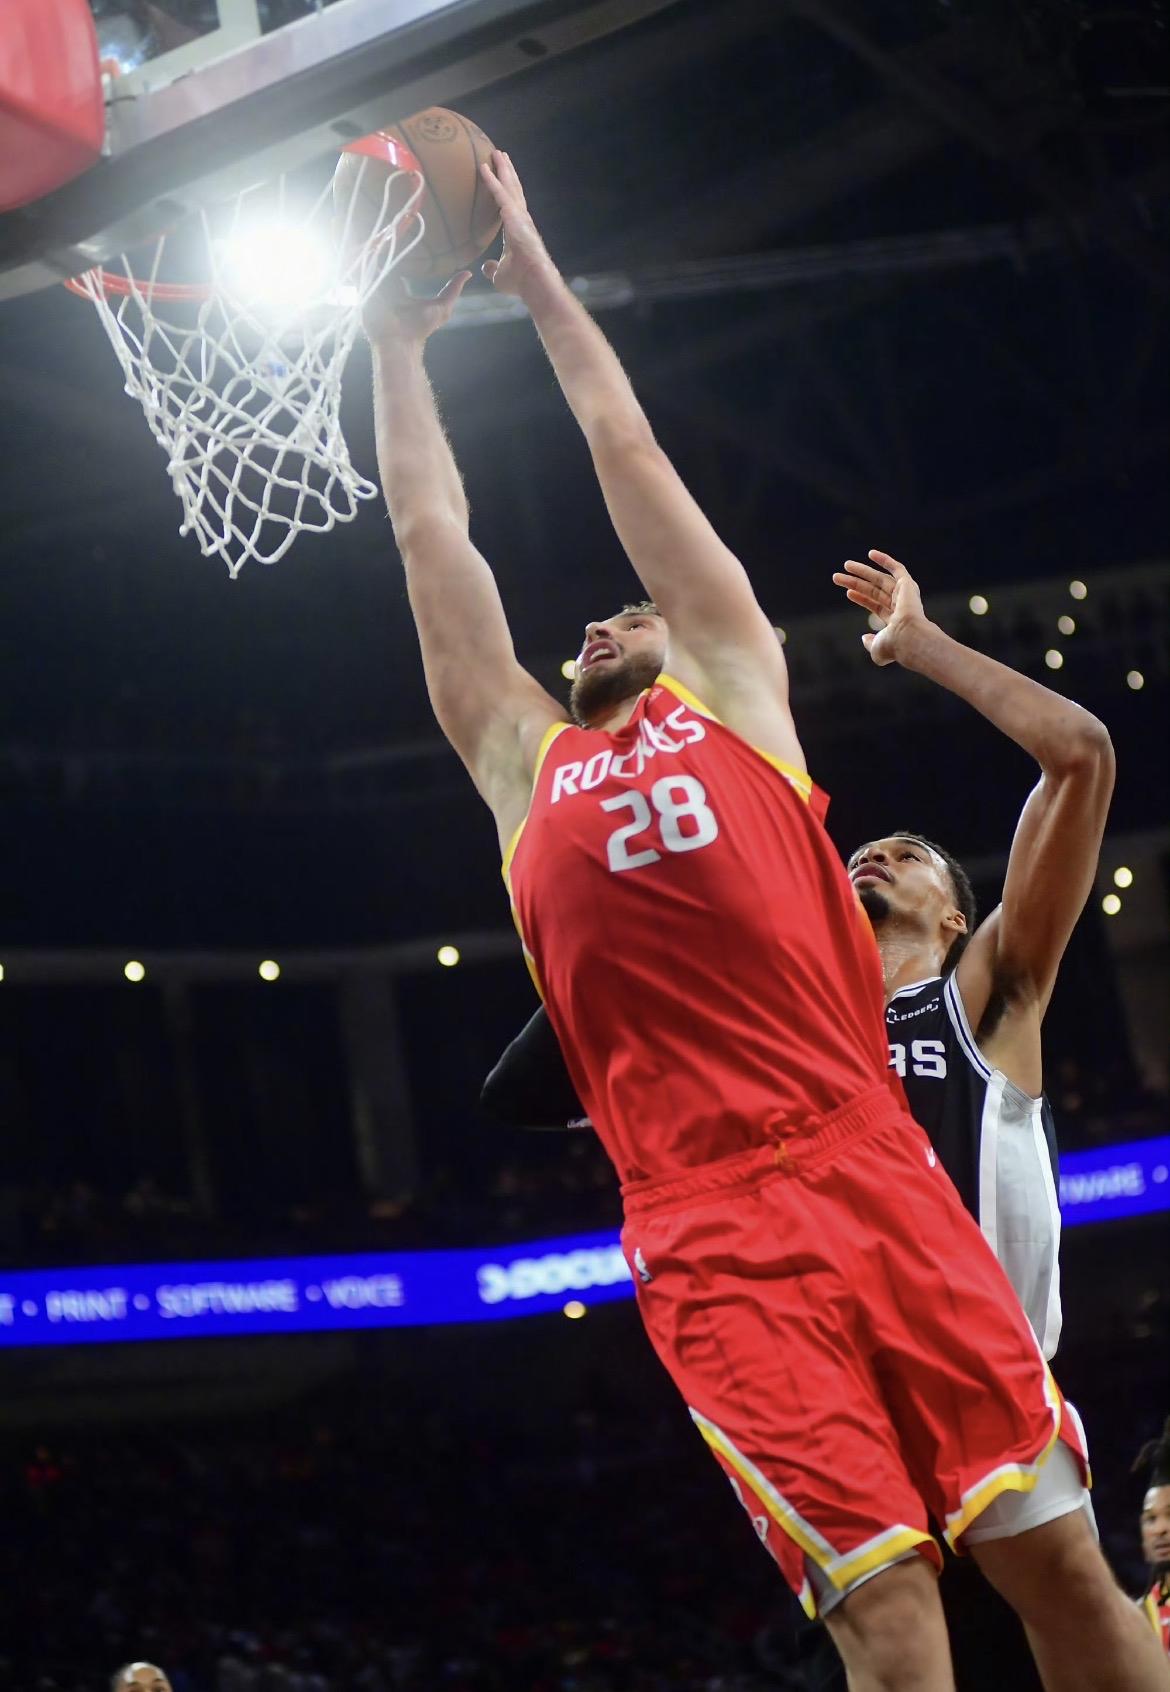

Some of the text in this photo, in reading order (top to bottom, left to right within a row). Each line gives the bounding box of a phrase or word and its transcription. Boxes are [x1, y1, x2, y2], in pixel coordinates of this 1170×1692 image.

[600, 774, 719, 873] 28
[893, 1003, 935, 1022] LEDGER
[46, 1288, 128, 1323] PRINT
[156, 1279, 299, 1319] SOFTWARE
